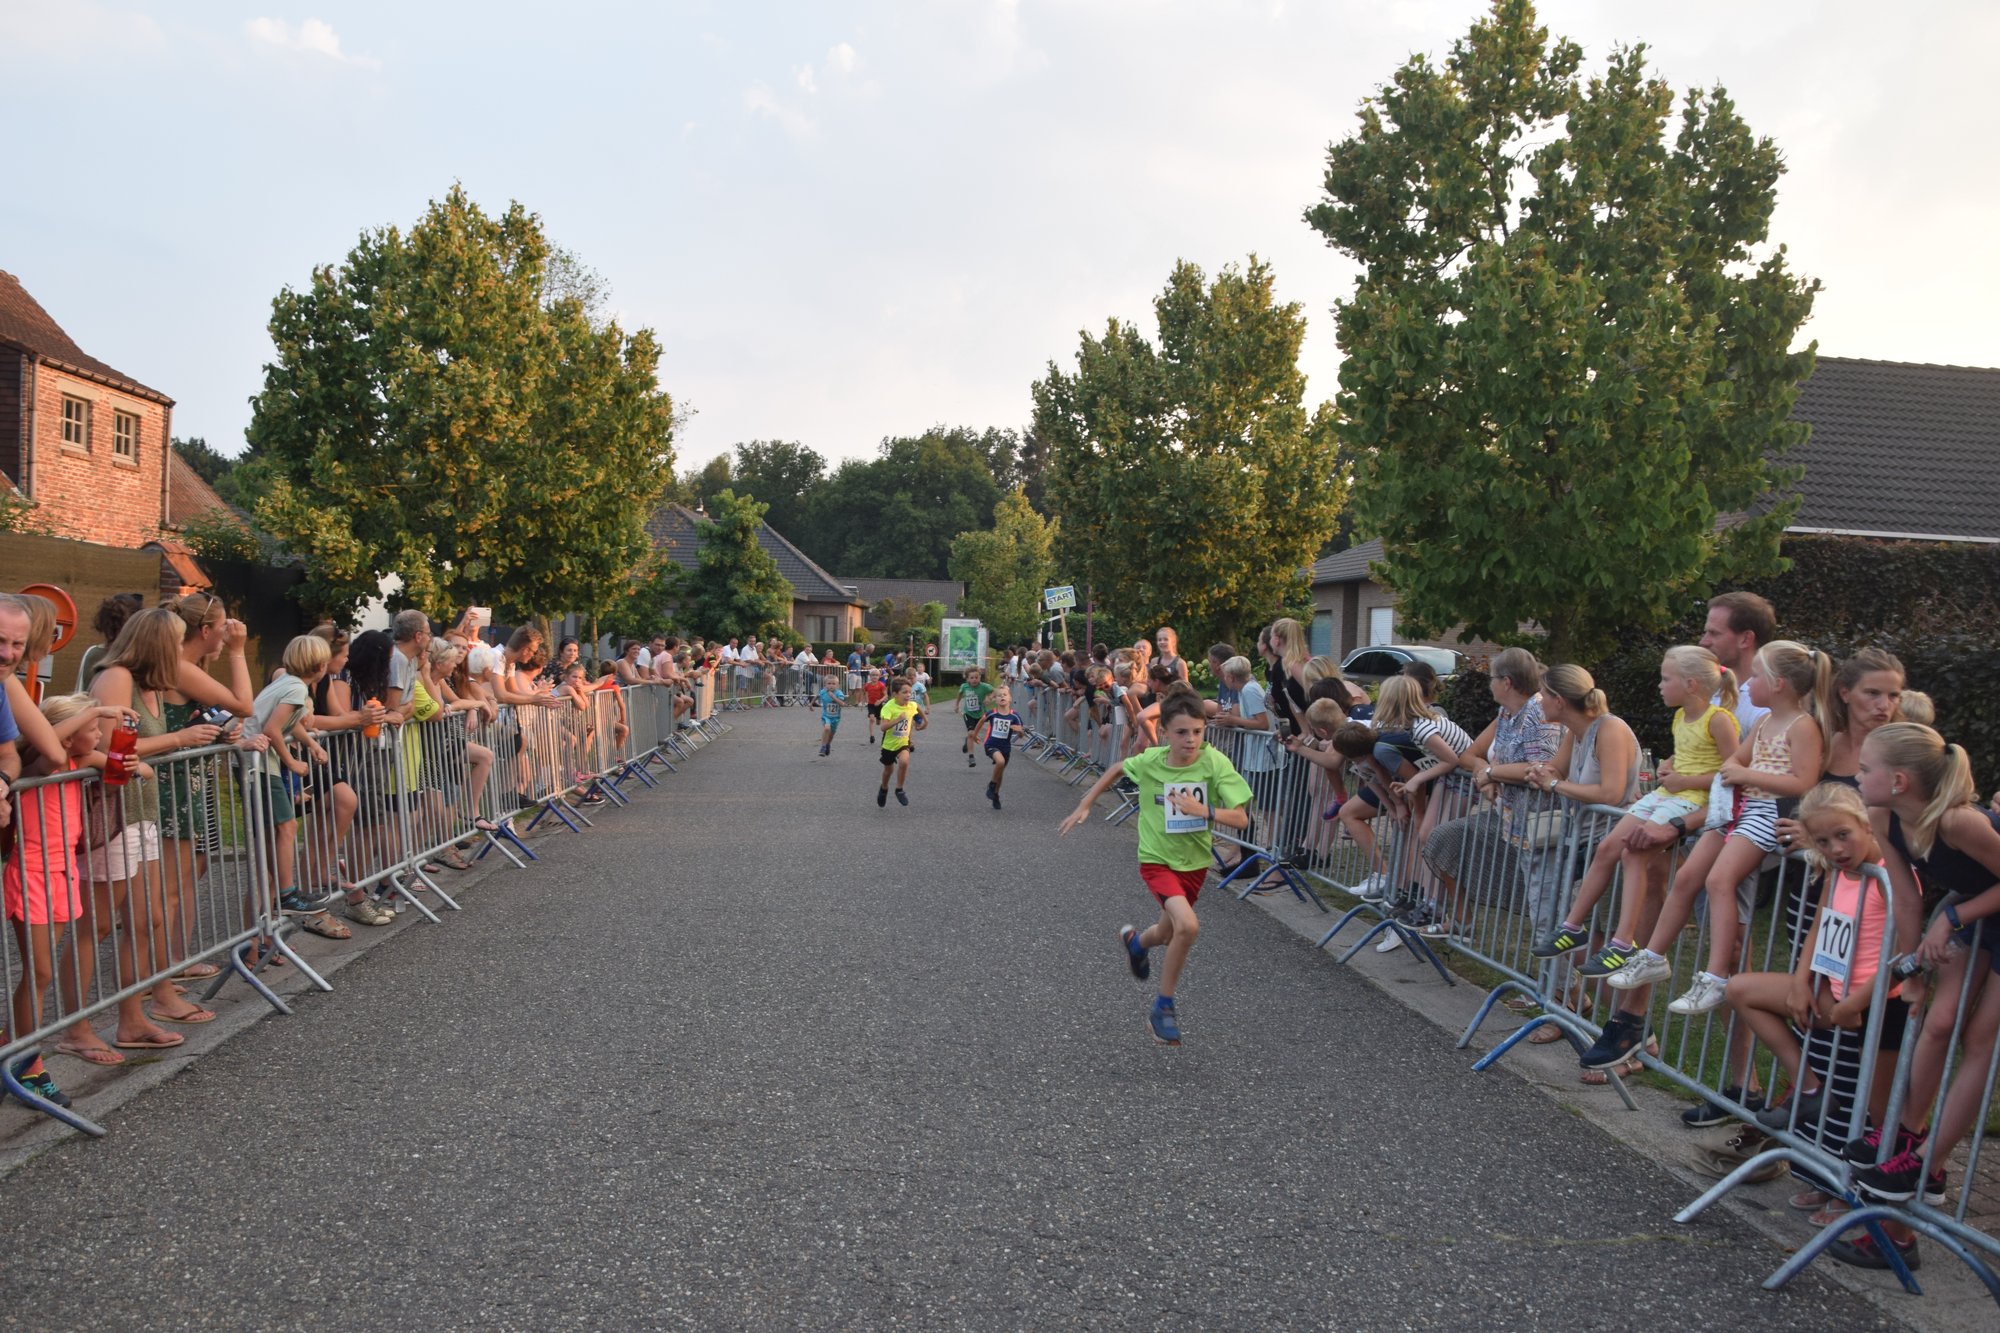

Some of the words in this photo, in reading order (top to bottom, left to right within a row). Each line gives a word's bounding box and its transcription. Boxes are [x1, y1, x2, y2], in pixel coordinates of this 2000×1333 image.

[1047, 590, 1073, 605] START
[967, 697, 978, 707] 127
[895, 719, 909, 731] 128
[994, 720, 1009, 732] 135
[1822, 914, 1852, 959] 170
